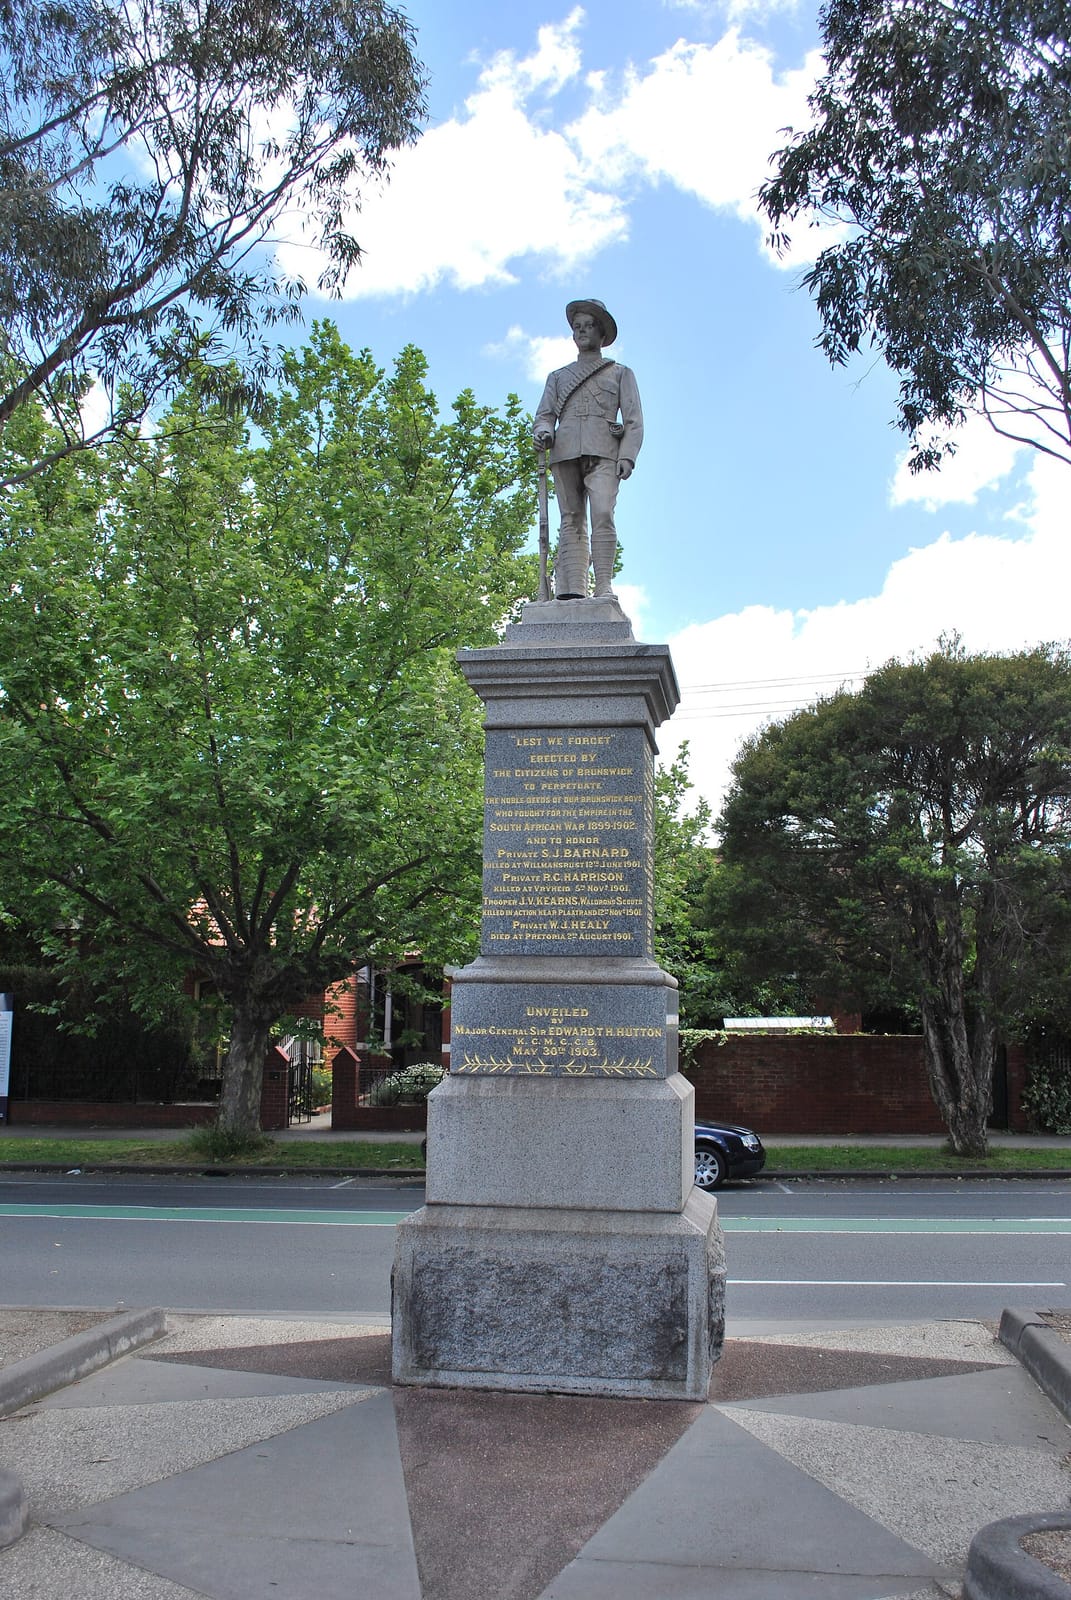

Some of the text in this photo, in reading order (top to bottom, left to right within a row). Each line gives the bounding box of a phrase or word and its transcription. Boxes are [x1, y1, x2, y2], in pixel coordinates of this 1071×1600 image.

[547, 737, 563, 746] WE
[530, 753, 597, 763] ERECTED BY
[515, 769, 559, 777] CITIZENS
[577, 768, 633, 777] BRUNSWICK
[541, 782, 603, 790] PERPETUATE
[581, 795, 623, 803] BRUNSWICK
[618, 808, 633, 816] THE
[490, 823, 522, 832] SOUTH
[524, 822, 561, 831] AFRICAN
[564, 822, 585, 831] WAR
[497, 849, 538, 858] PRIVATE
[502, 873, 541, 882] PRIVATE
[483, 897, 517, 906] TROOPER
[512, 921, 548, 929] PRIVATE
[578, 932, 612, 940] AUGUST
[526, 1007, 589, 1017] UNVEILED
[455, 1025, 487, 1035] MAJOR
[488, 1026, 528, 1035] GENERAL
[529, 1026, 546, 1036] SIR
[512, 1046, 538, 1055] MAY
